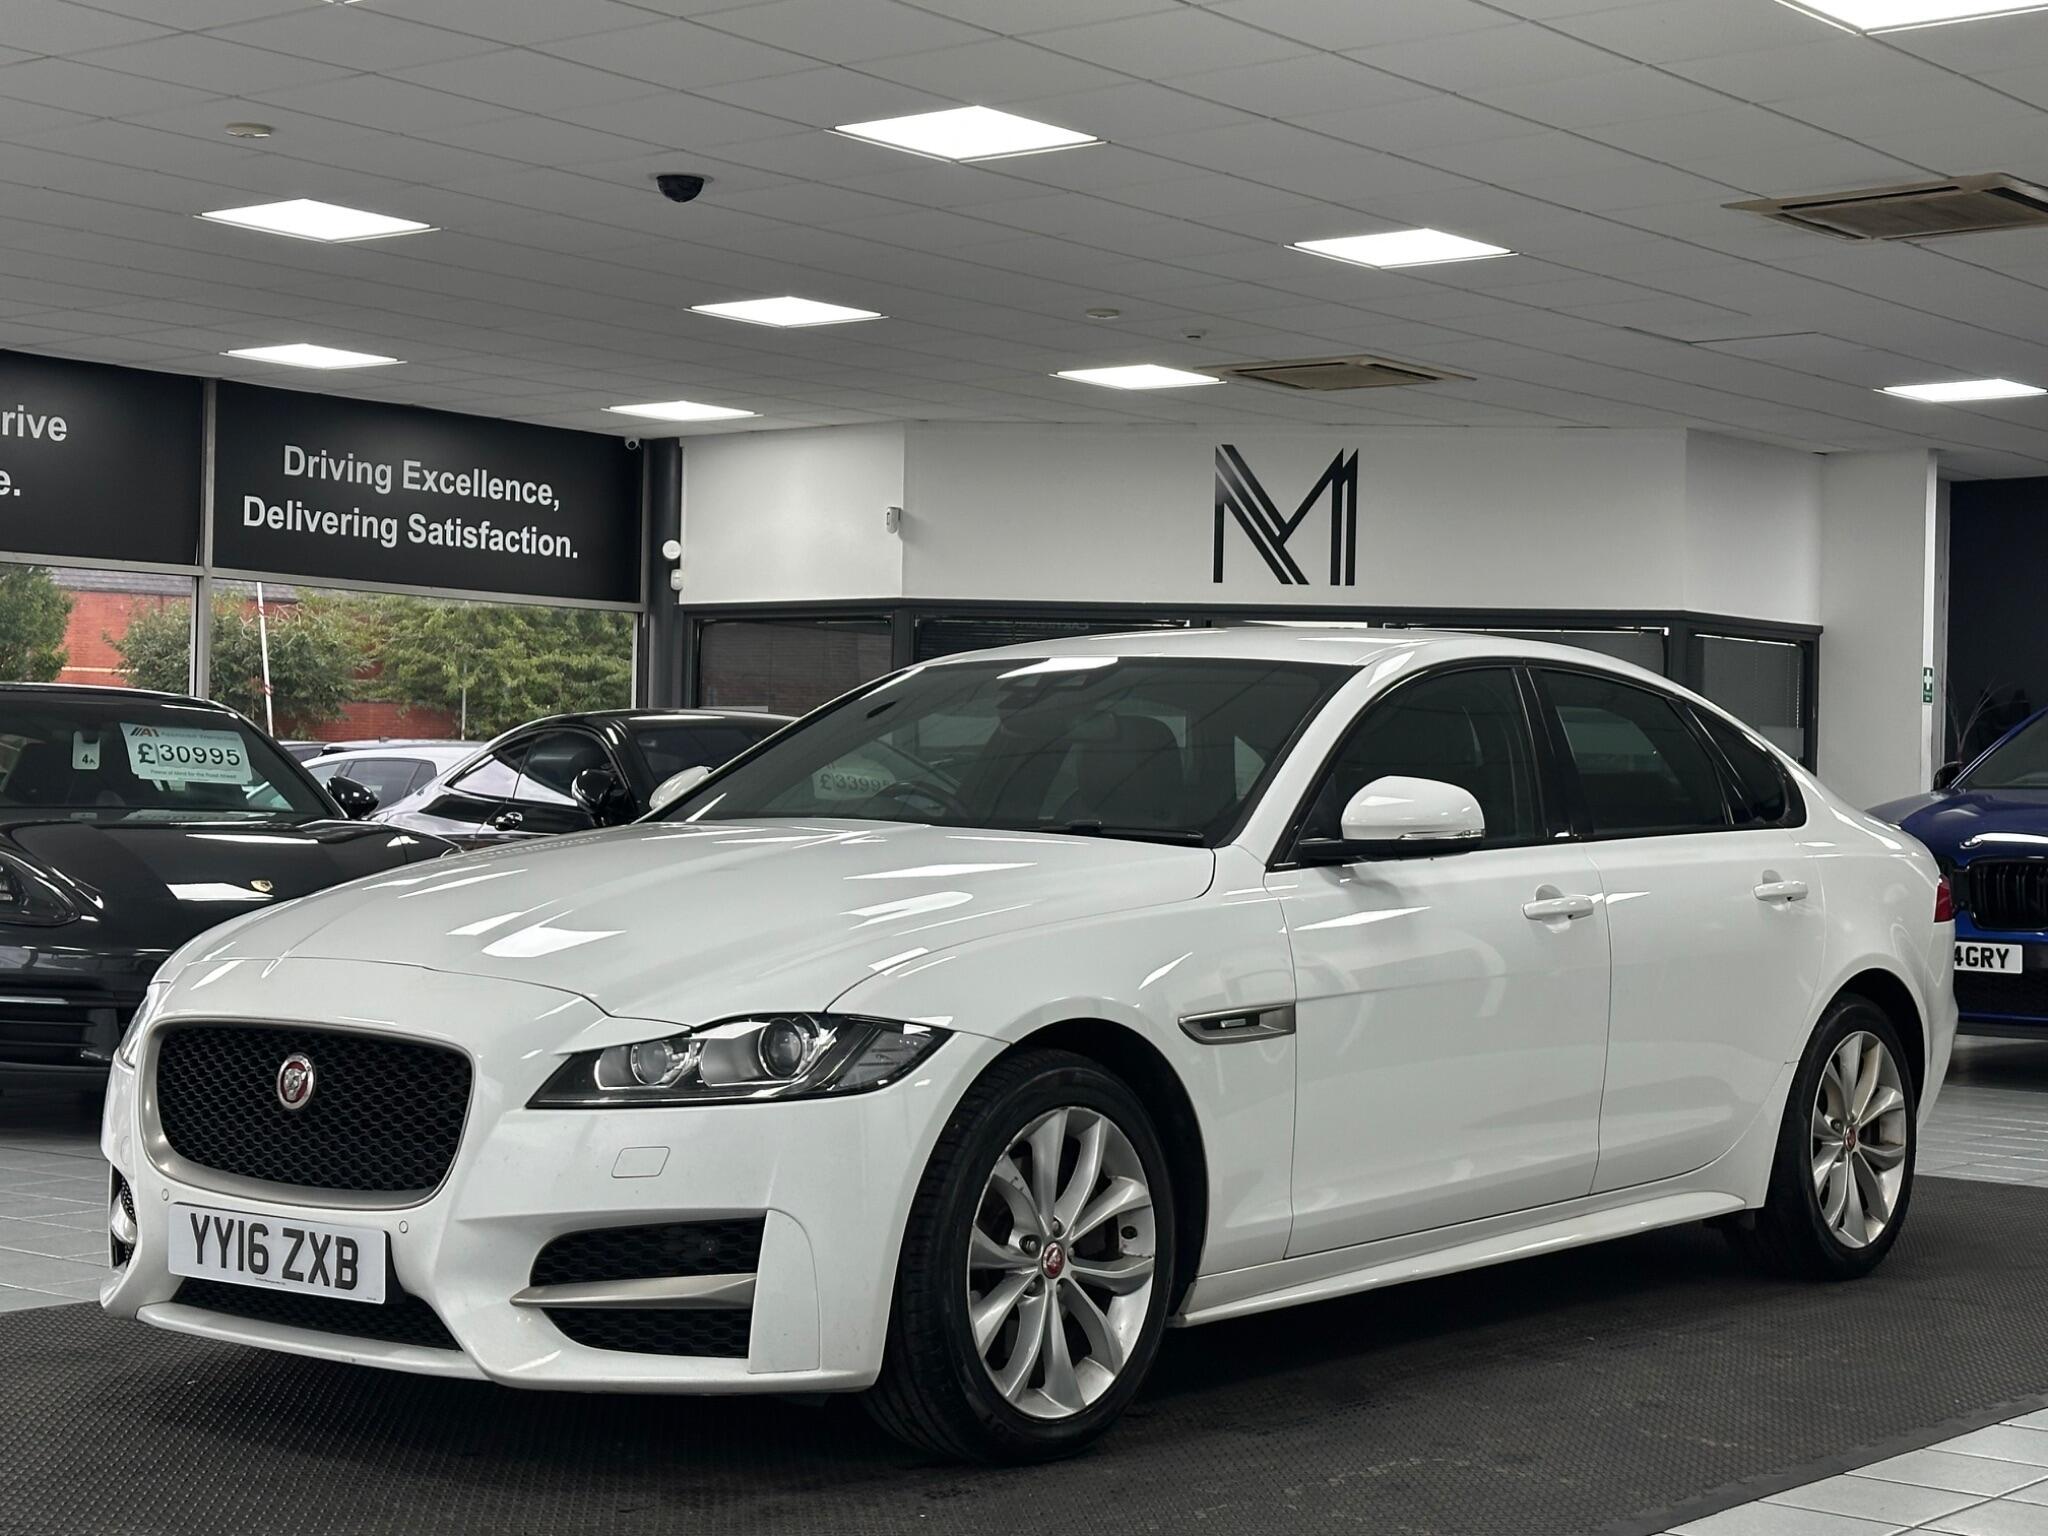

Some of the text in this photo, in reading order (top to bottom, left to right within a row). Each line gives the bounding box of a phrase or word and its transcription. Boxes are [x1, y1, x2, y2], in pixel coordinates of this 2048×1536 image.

[284, 445, 560, 512] Driving Excellence,
[243, 495, 579, 559] Delivering Satisfaction.
[820, 773, 890, 792] £3399
[190, 1212, 359, 1291] YY16 ZXB
